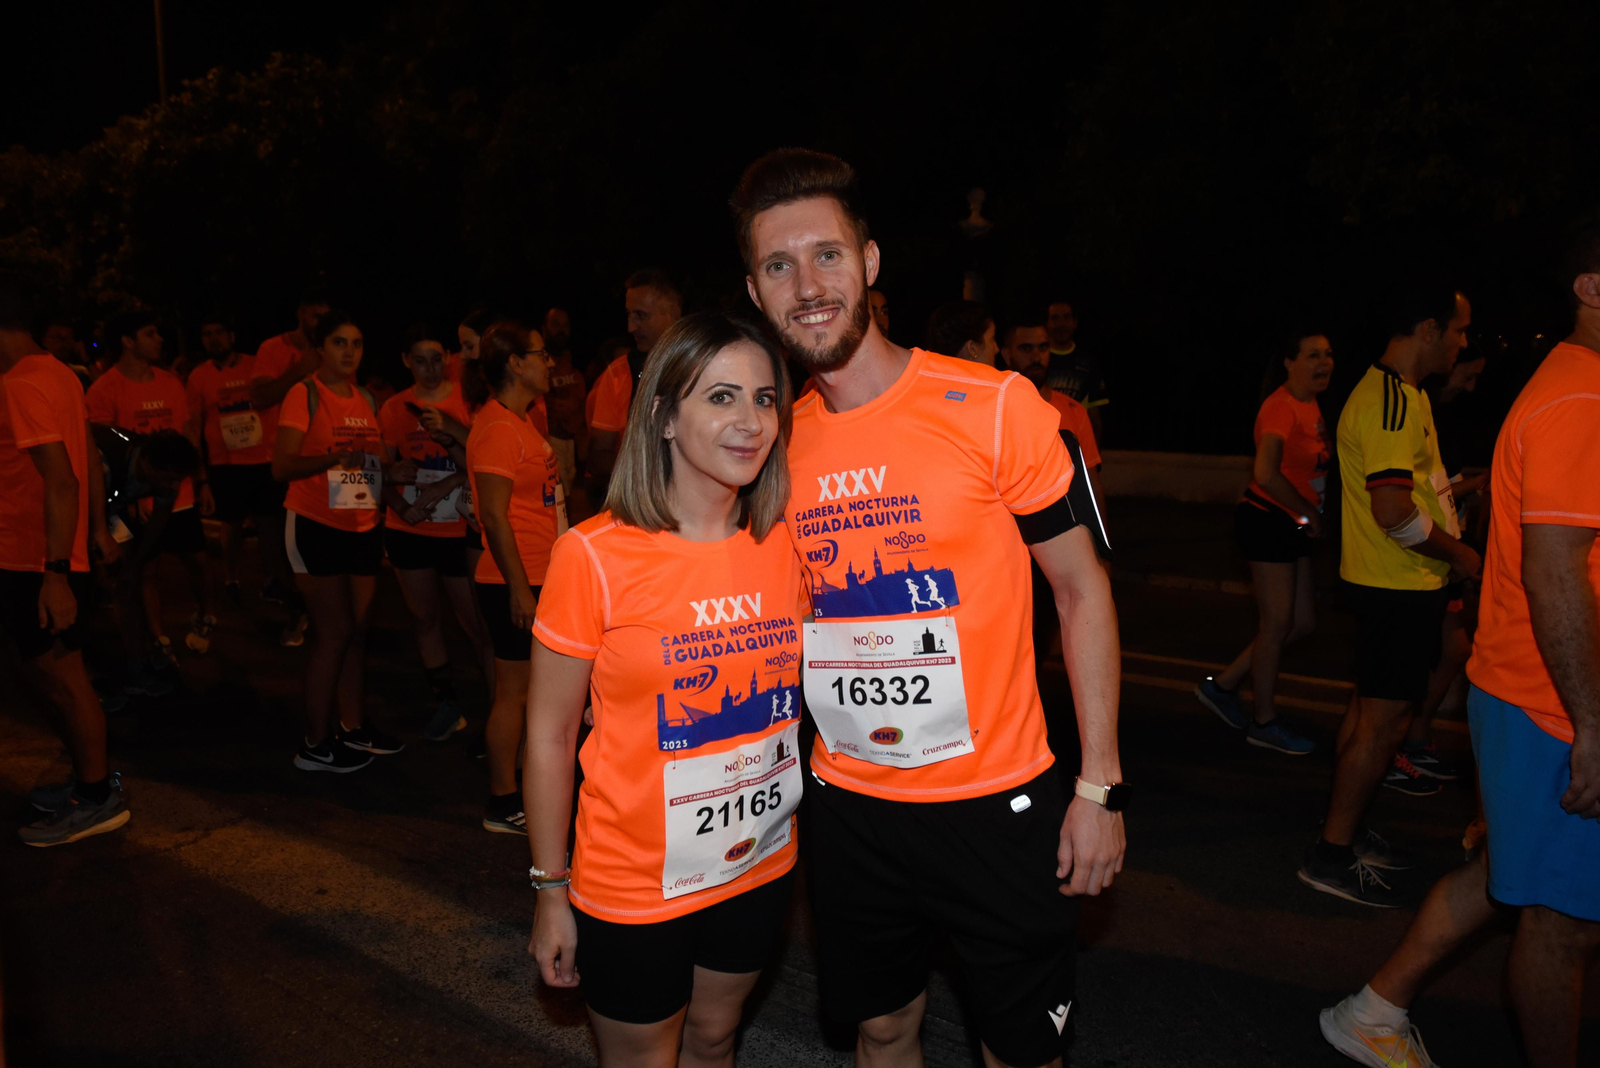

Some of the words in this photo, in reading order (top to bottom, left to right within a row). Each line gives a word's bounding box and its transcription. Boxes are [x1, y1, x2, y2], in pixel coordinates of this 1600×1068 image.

[341, 473, 375, 485] 20256
[817, 465, 887, 502] XXXV
[795, 503, 844, 522] CARRERA
[848, 494, 920, 512] NOCTURNA
[802, 508, 922, 537] GUADALQUIVIR
[689, 592, 761, 627] XXXV
[660, 628, 725, 647] CARRERA
[729, 617, 795, 637] NOCTURNA
[674, 629, 798, 662] GUADALQUIVIR
[662, 648, 671, 665] DEL
[883, 659, 926, 668] GUADALQUIVIR
[832, 675, 932, 706] 16332
[662, 739, 688, 750] 2023
[922, 739, 963, 755] Cruzcampo
[672, 796, 689, 805] XXXV
[689, 791, 714, 801] CARRERA
[696, 782, 782, 835] 21165
